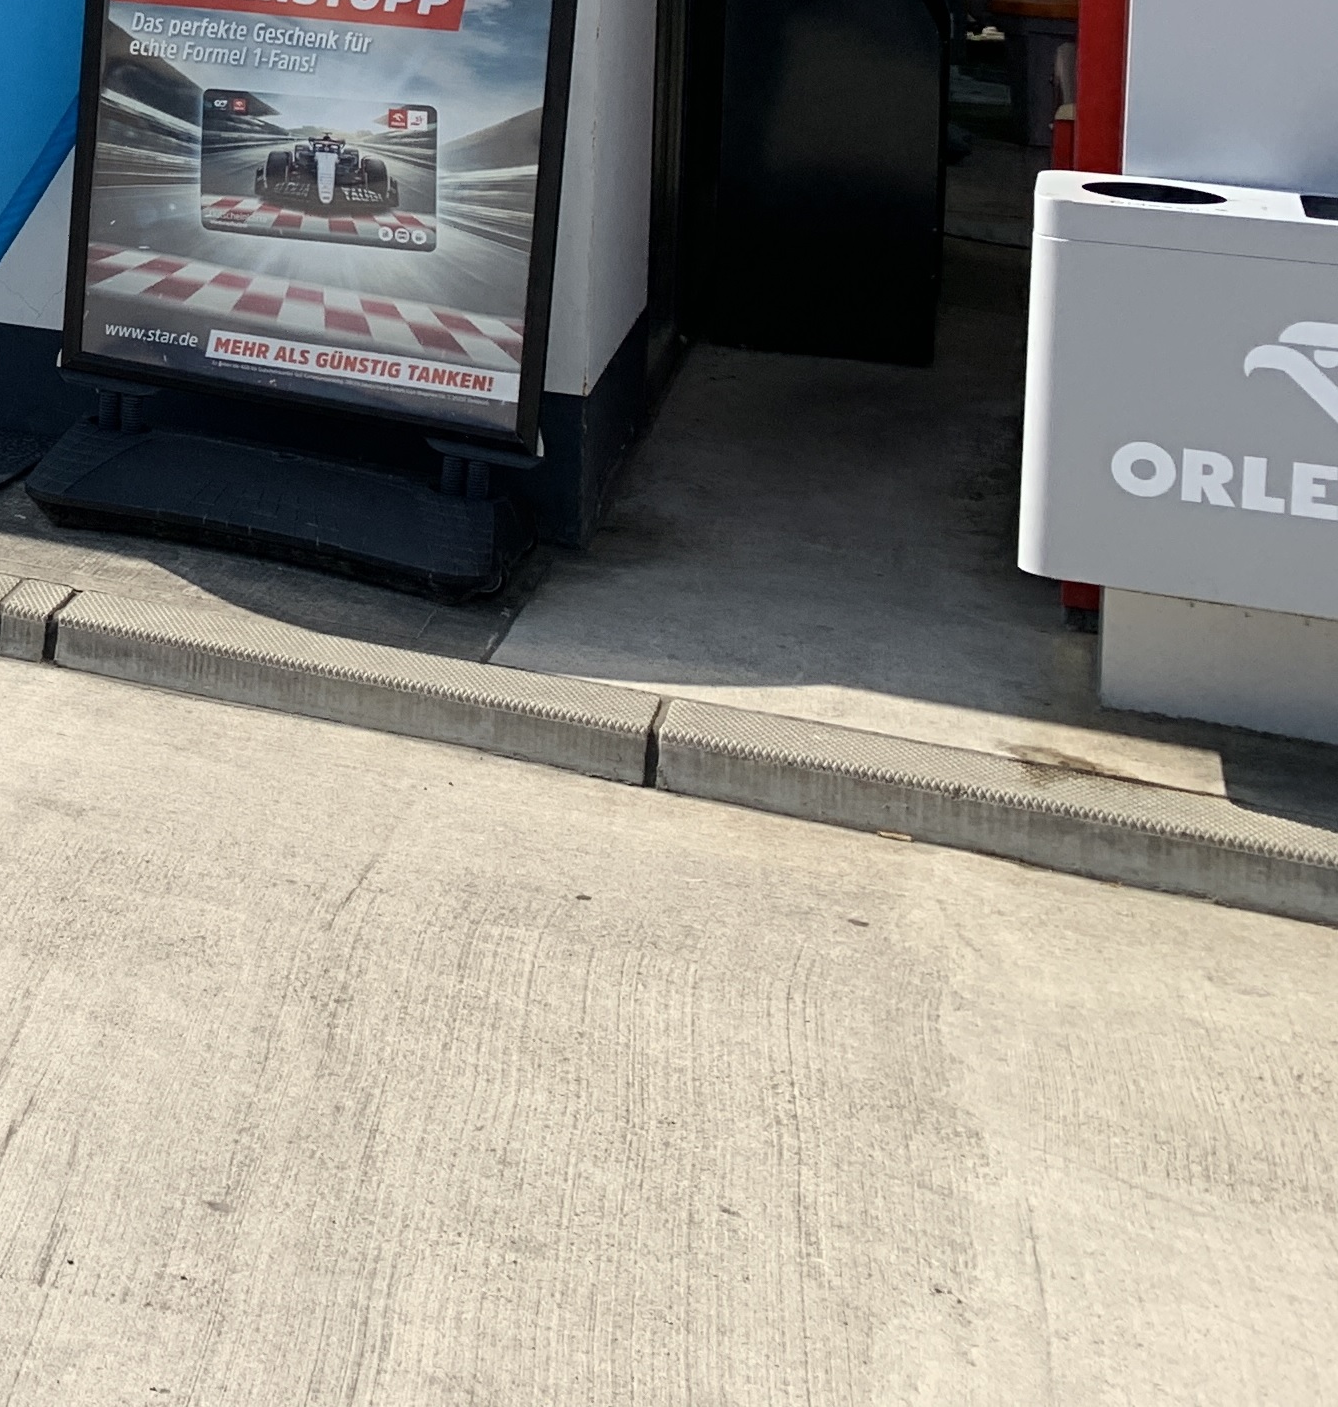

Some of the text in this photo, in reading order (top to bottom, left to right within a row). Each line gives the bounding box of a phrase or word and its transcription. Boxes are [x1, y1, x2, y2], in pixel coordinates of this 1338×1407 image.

[131, 12, 373, 54] Das perfekte Geschenk für
[129, 39, 317, 73] echte Formel 1-Fans!
[104, 323, 199, 347] www.star.de
[213, 336, 270, 360] MEHR
[274, 346, 310, 366] ALS
[316, 349, 402, 379] GÜNSTIG
[407, 364, 494, 392] TANKEN!
